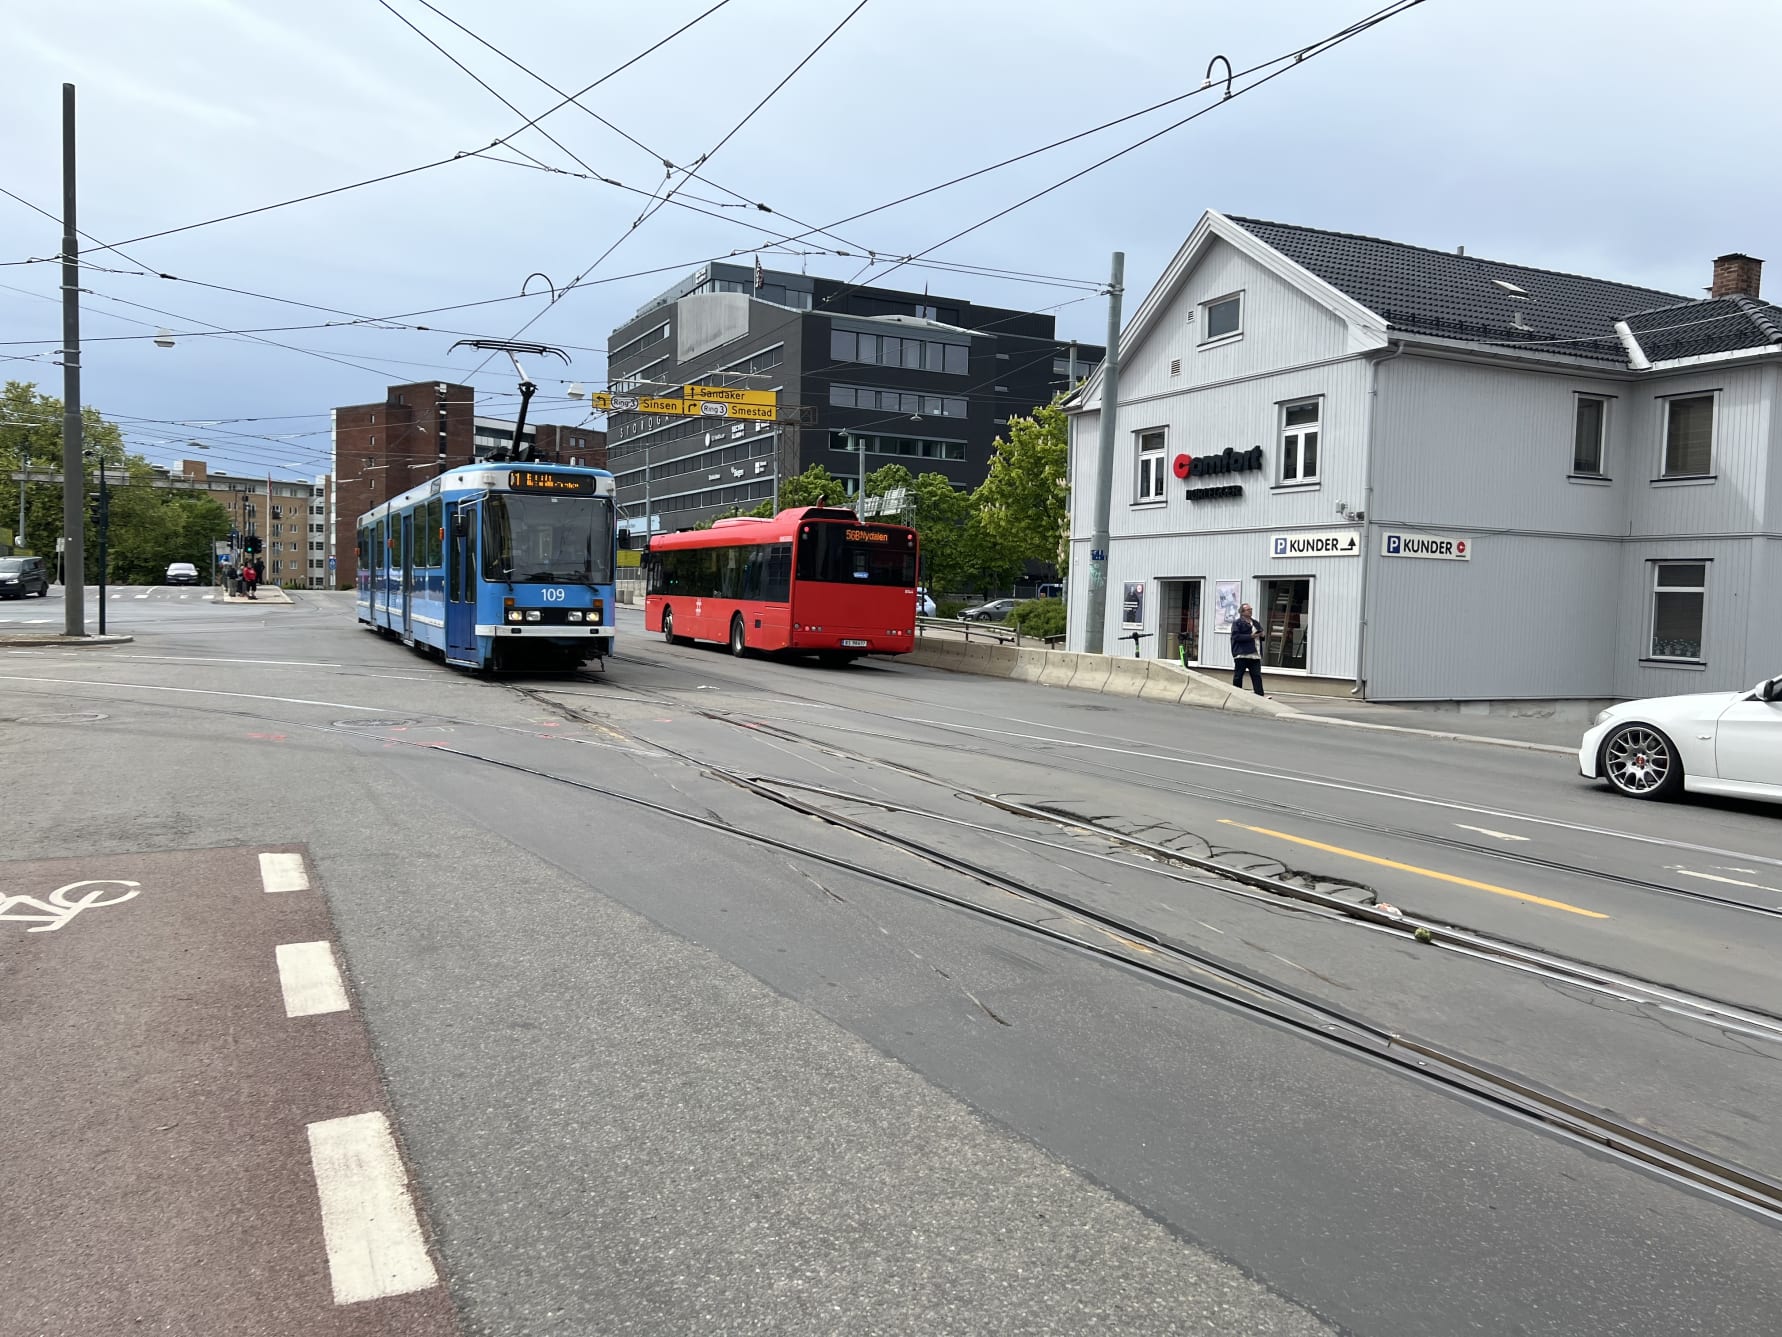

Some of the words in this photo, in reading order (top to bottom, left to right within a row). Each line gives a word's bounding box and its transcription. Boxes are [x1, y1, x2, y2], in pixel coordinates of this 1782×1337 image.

[700, 387, 745, 400] Sandaker
[613, 398, 629, 408] Ring
[630, 399, 636, 408] 3
[643, 399, 677, 411] Sinsen
[703, 404, 718, 414] Ring
[719, 405, 725, 414] 3
[732, 405, 772, 417] Smestad
[1173, 445, 1262, 479] Comfort
[860, 530, 888, 542] Nydalen
[1290, 538, 1339, 553] KUNDER
[1404, 538, 1453, 555] KUNDER
[541, 588, 565, 602] 109
